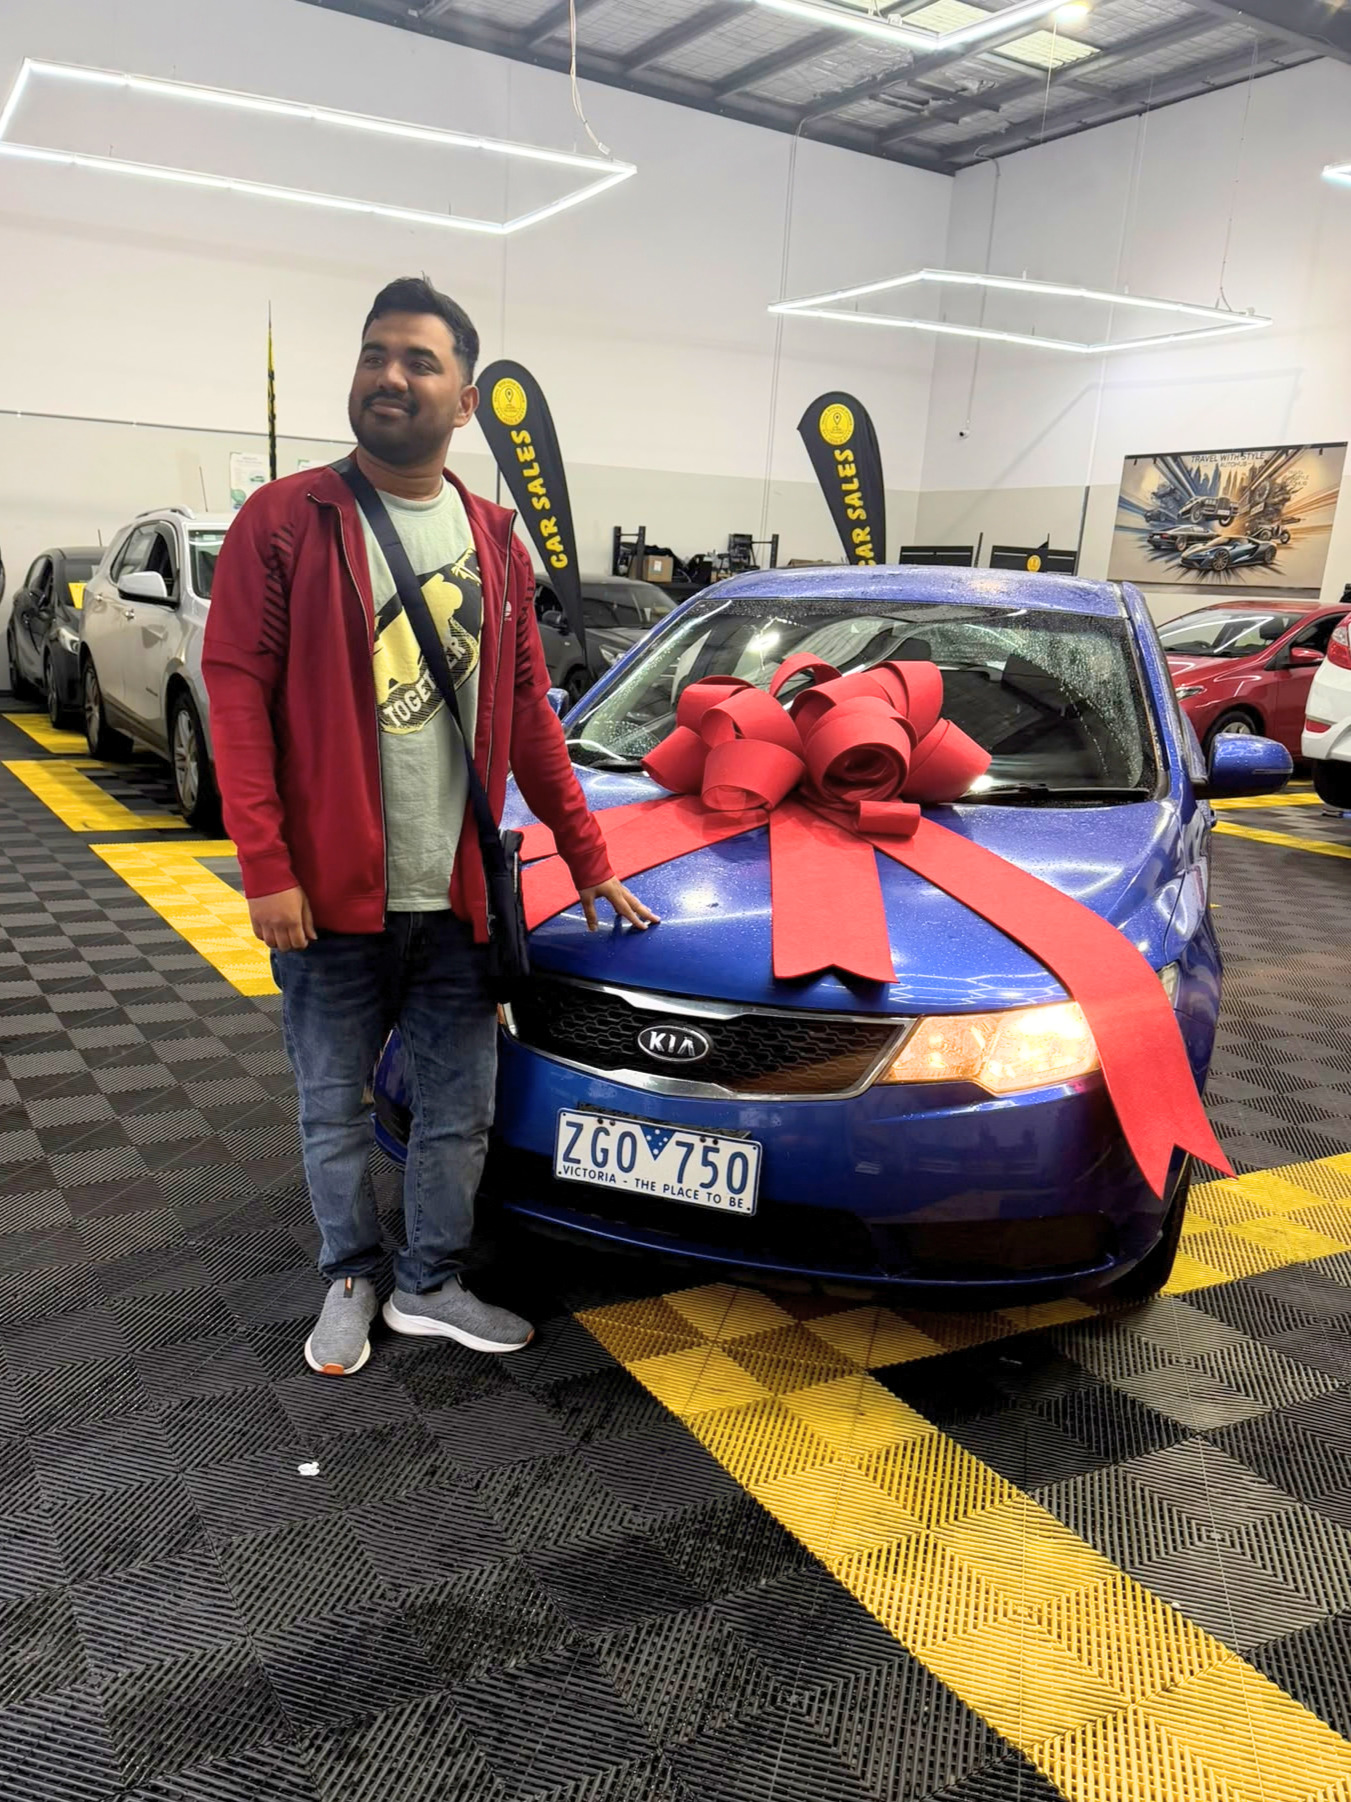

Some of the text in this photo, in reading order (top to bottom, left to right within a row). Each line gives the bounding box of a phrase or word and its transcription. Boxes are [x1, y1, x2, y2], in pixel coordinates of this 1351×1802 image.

[834, 449, 867, 520] SALES
[1191, 455, 1218, 463] TRAVEL
[1220, 453, 1239, 461] WITH
[510, 429, 568, 569] CAR SALES
[383, 637, 466, 727] TOGETER
[649, 1031, 695, 1056] KIA
[562, 1121, 749, 1195] ZGO 750
[563, 1165, 616, 1183] VICTORIA
[634, 1178, 656, 1192] THE
[663, 1184, 699, 1200] PLACE
[706, 1191, 722, 1204] TO
[729, 1197, 744, 1208] BE
